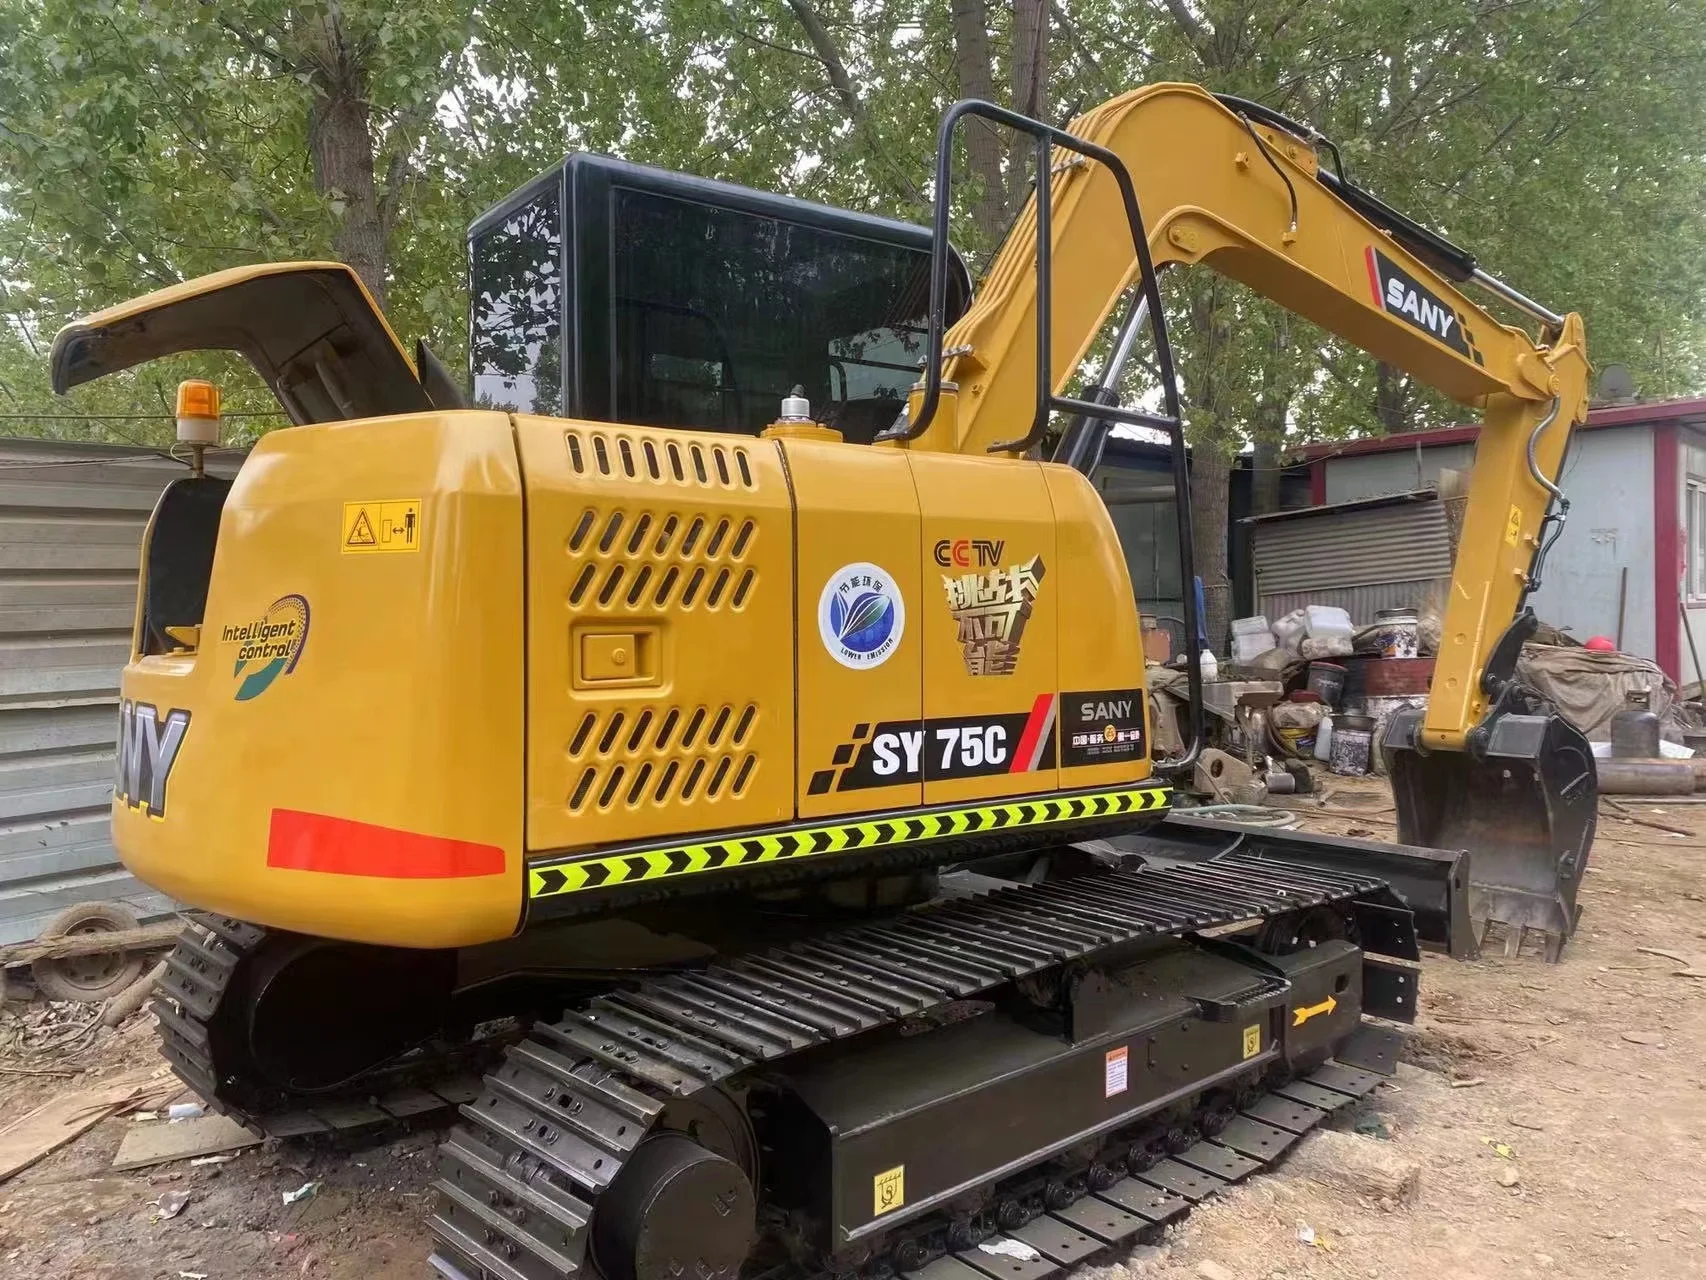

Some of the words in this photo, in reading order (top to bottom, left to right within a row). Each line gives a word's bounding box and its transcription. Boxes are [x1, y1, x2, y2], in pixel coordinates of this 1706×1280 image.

[1387, 277, 1454, 338] SANY
[934, 540, 1005, 567] CCTV
[222, 619, 296, 643] Intelligent
[239, 640, 290, 660] control
[841, 647, 861, 660] LOWER
[867, 637, 894, 660] EMISSION
[1081, 700, 1132, 721] SANY
[872, 730, 926, 775] SY
[936, 725, 1007, 769] 75C
